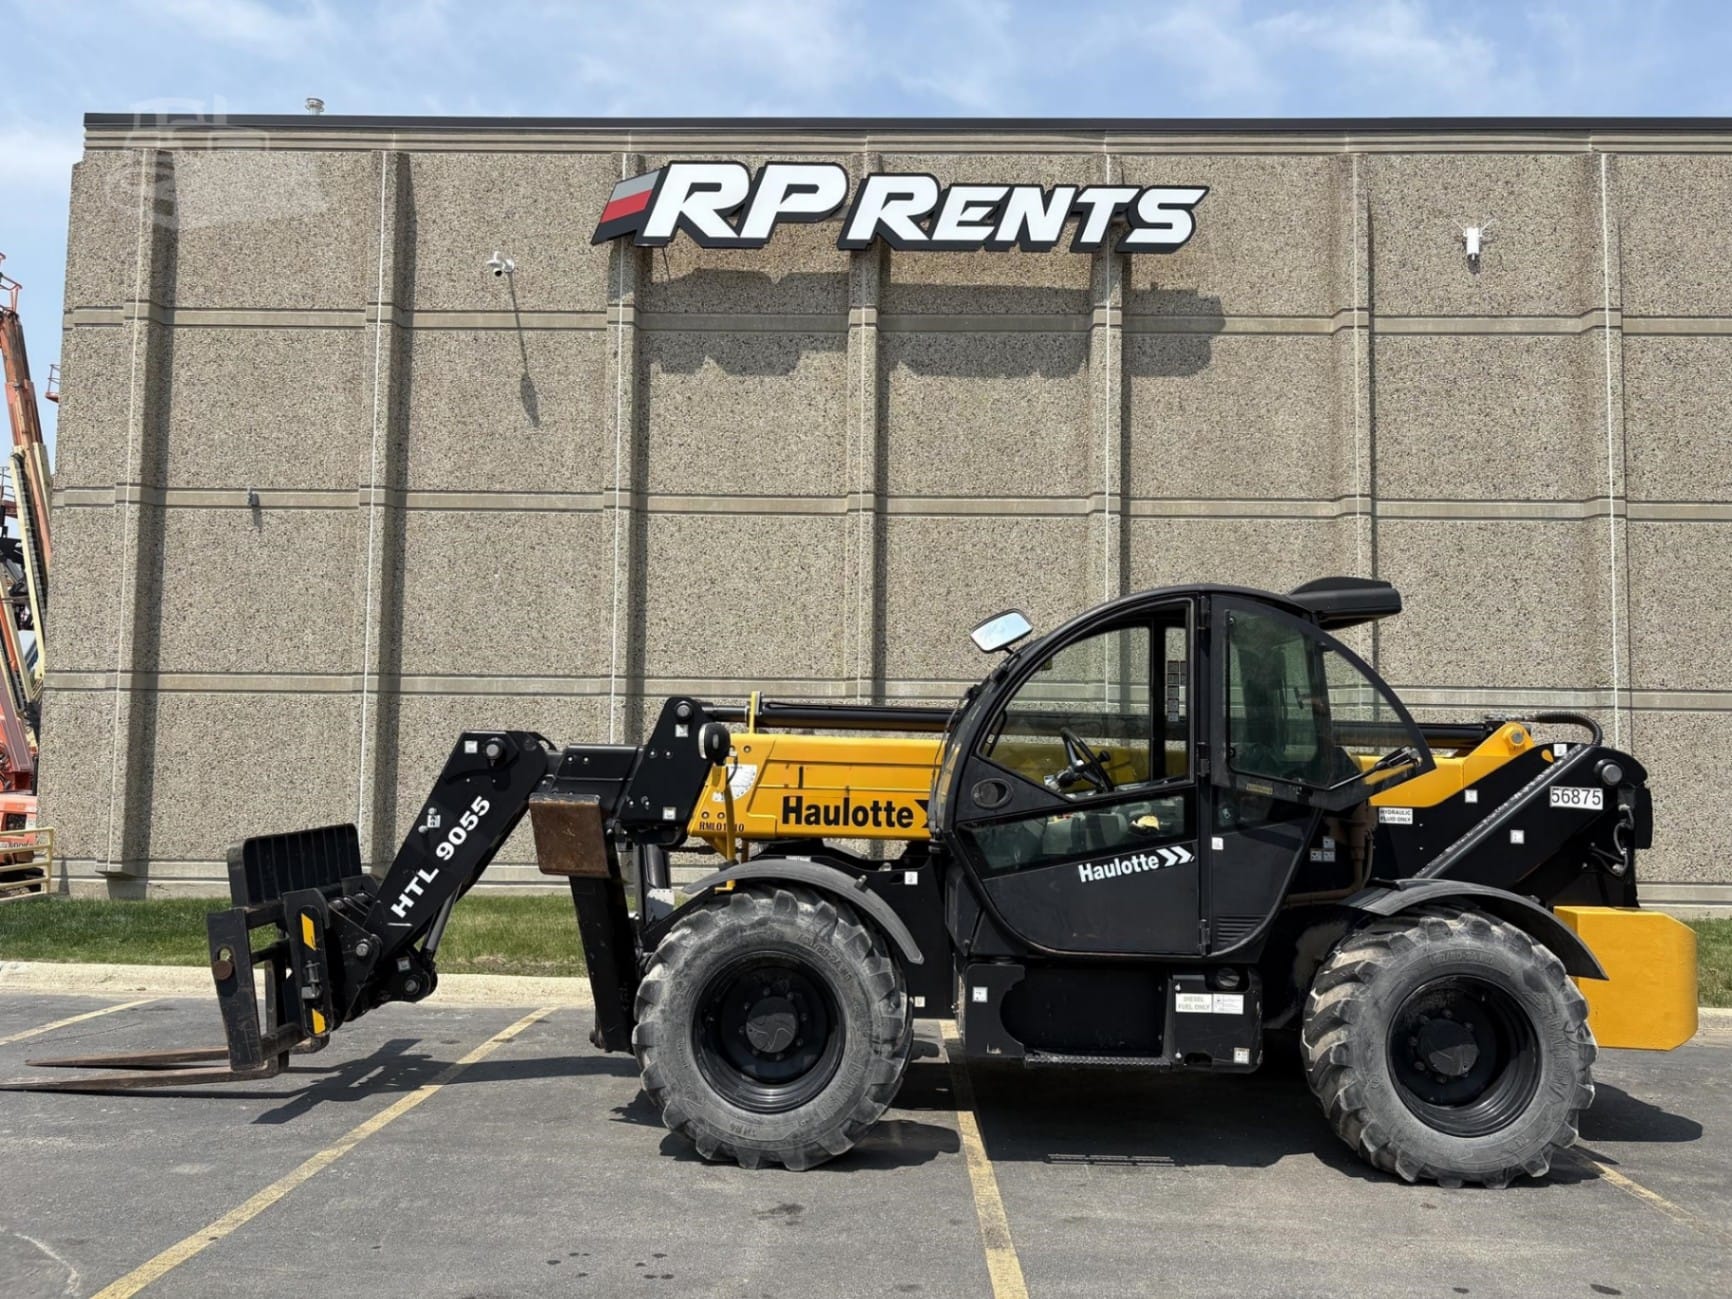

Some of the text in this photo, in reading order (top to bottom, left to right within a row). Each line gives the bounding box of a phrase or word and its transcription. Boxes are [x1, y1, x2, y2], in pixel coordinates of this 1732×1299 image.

[640, 162, 1209, 245] RP RENTS
[782, 796, 914, 828] Haulotte
[1551, 787, 1601, 806] 56875
[390, 796, 490, 918] HTL 9055
[1078, 854, 1159, 882] Haulotte
